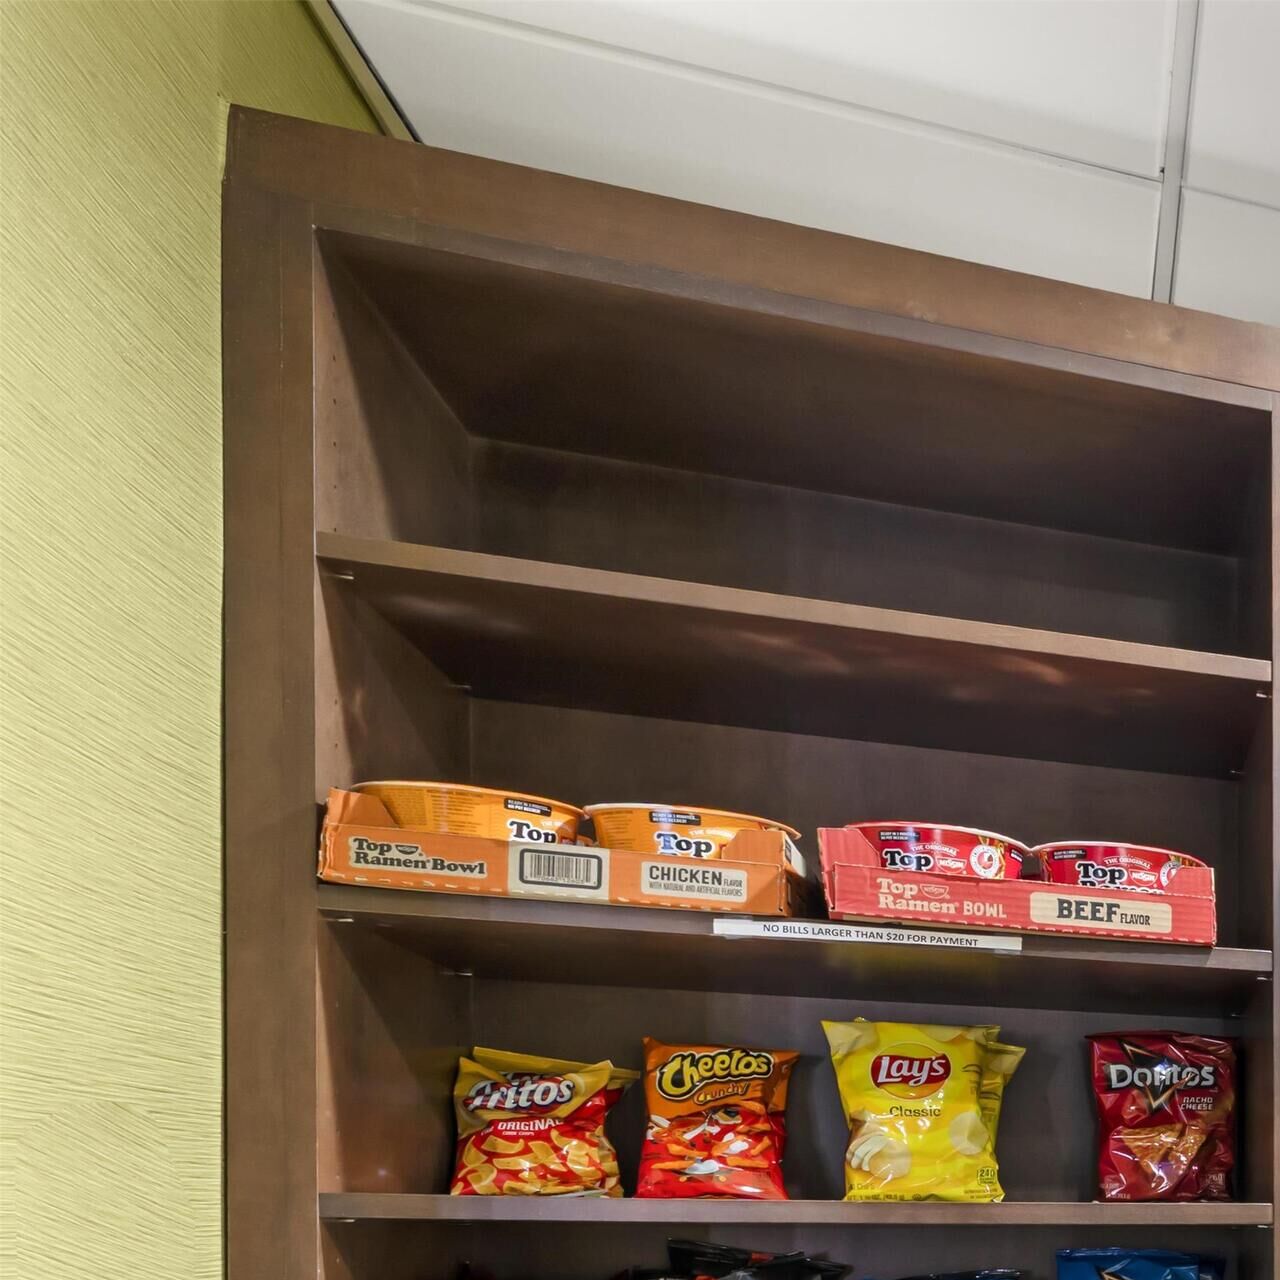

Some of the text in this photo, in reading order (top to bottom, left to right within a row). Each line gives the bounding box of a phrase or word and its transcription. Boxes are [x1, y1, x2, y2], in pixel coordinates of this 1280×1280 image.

[353, 838, 392, 856] Top
[656, 832, 713, 857] Top
[354, 851, 485, 875] Ramen Bowl
[884, 850, 932, 871] Top
[650, 865, 743, 888] CHICKEN FLAVOR
[1077, 863, 1126, 884] Top
[876, 877, 919, 899] Top
[878, 894, 1007, 918] Ramen BOWL
[1056, 898, 1151, 926] BEEF FLAVOR
[763, 923, 979, 947] NO BILLS LARGER THAN $20 FOR PAYMENT
[661, 1050, 769, 1096] Cheetos
[877, 1055, 946, 1087] Lay's
[1110, 1064, 1215, 1089] Doritos
[468, 1080, 575, 1111] Fritos
[1181, 1103, 1213, 1111] CHEESE
[1183, 1096, 1213, 1104] NACHO
[889, 1105, 941, 1117] Classic
